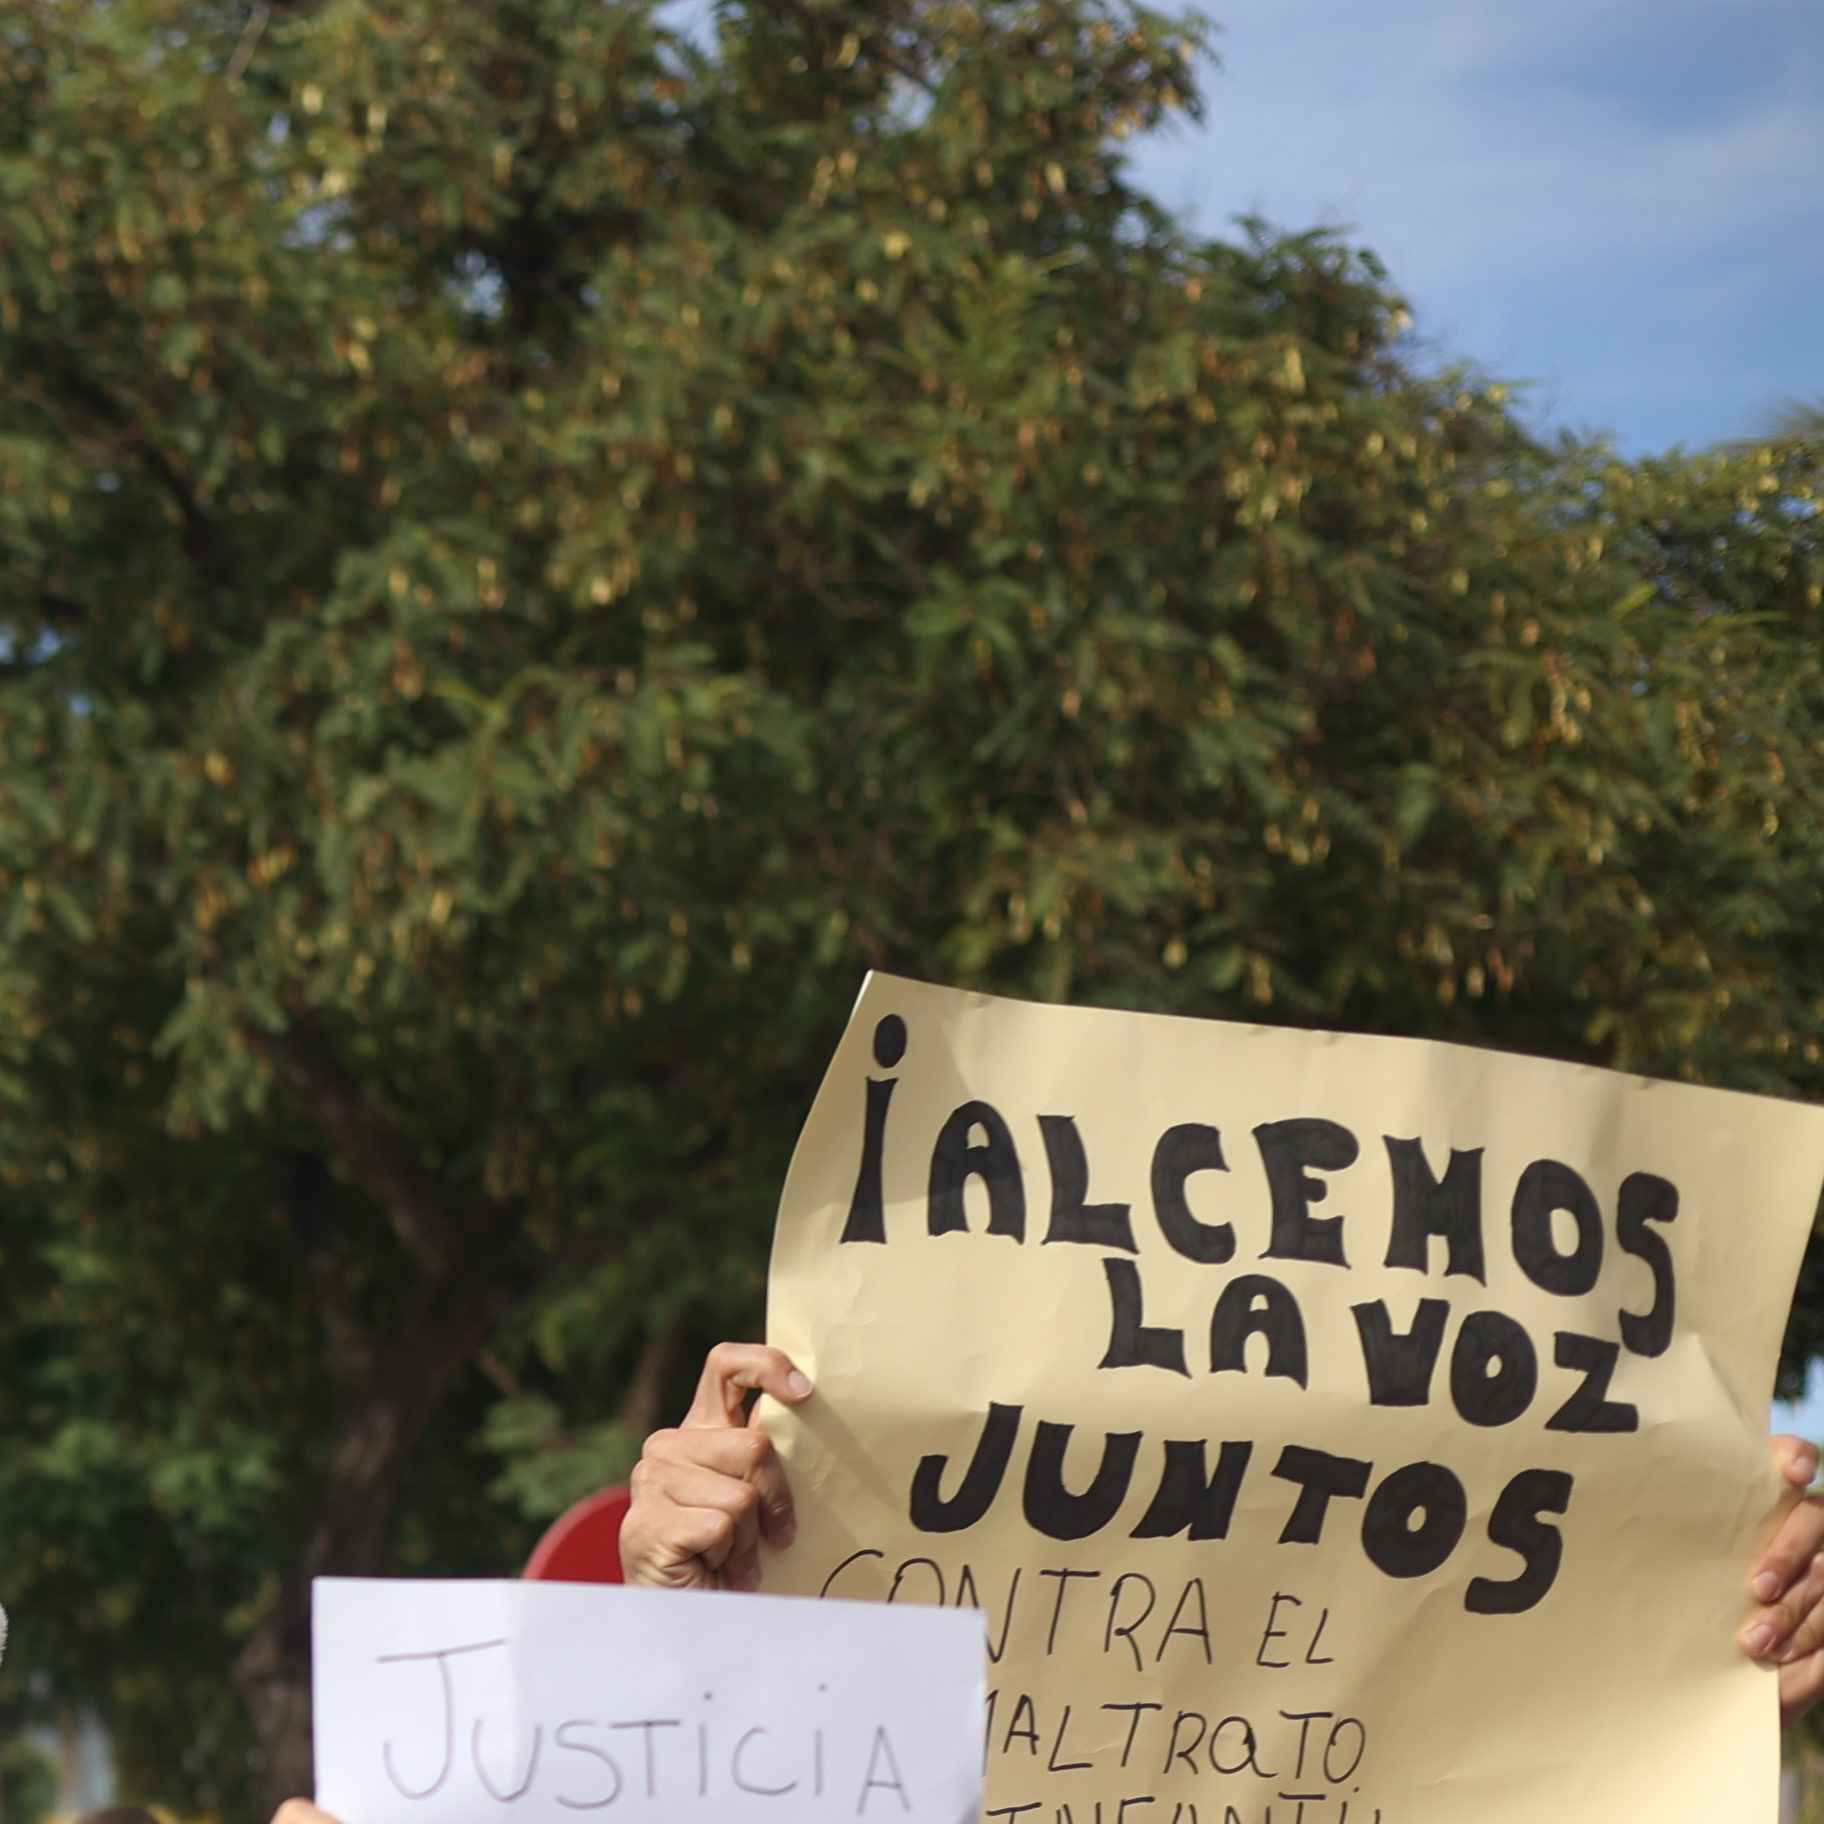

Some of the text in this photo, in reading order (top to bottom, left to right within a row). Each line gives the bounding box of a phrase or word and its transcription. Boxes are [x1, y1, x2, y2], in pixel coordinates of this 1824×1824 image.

[1098, 1257, 1642, 1435] LA VOZ
[907, 1402, 1575, 1616] JUNTOS
[1255, 1591, 1336, 1668] EL
